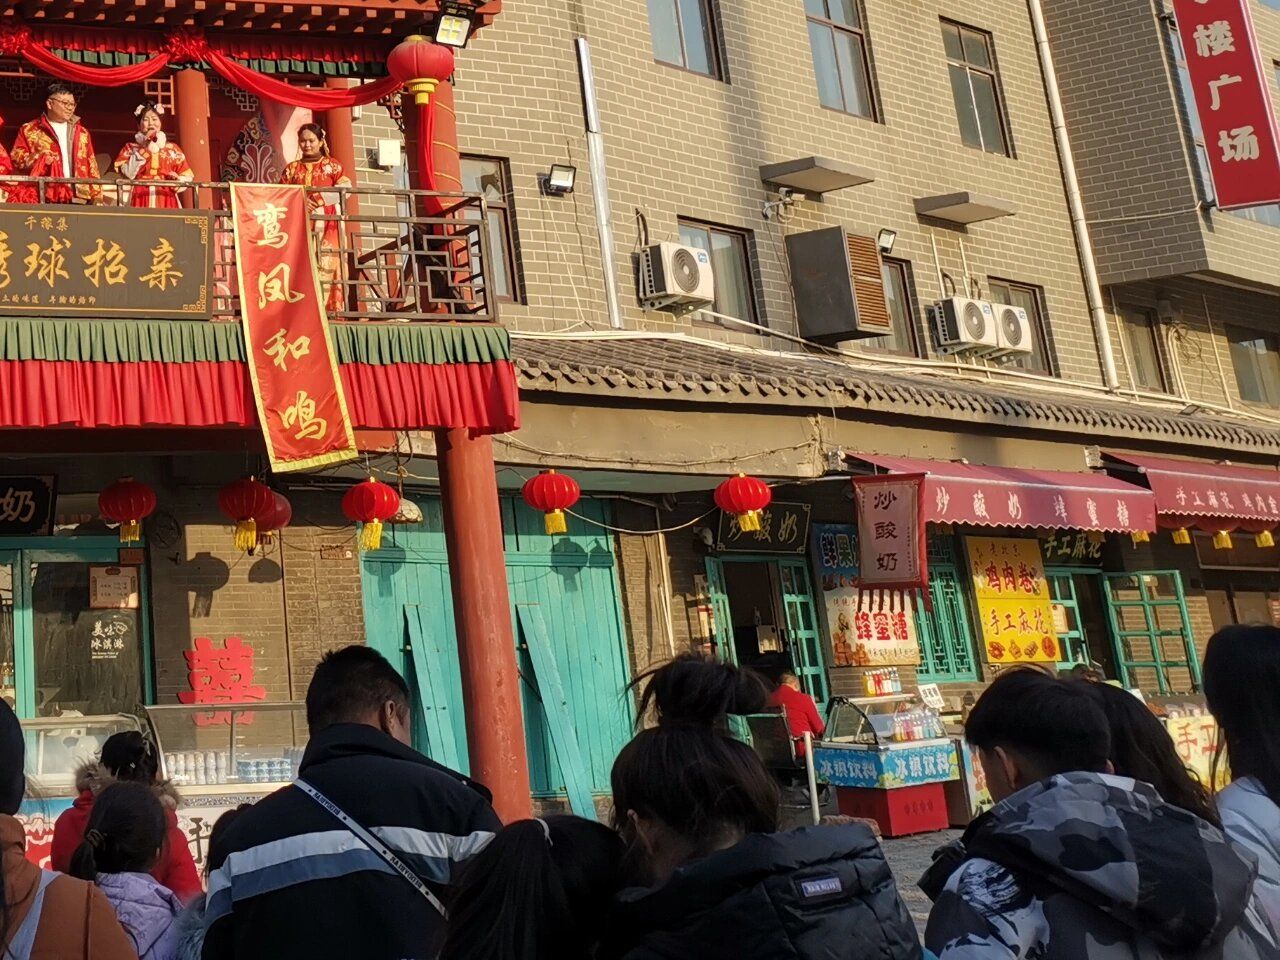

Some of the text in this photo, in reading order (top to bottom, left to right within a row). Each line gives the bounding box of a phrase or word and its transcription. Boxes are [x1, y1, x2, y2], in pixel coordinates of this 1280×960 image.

[252, 202, 327, 441] 鸾凤和鸣
[936, 486, 1022, 520] 炒酸奶
[1176, 486, 1235, 510] 手工麻花
[873, 490, 899, 572] 炒酸奶
[1044, 531, 1101, 559] 手工麻花
[855, 611, 908, 641] 蜂蜜糖
[990, 607, 1049, 635] 手工麻花
